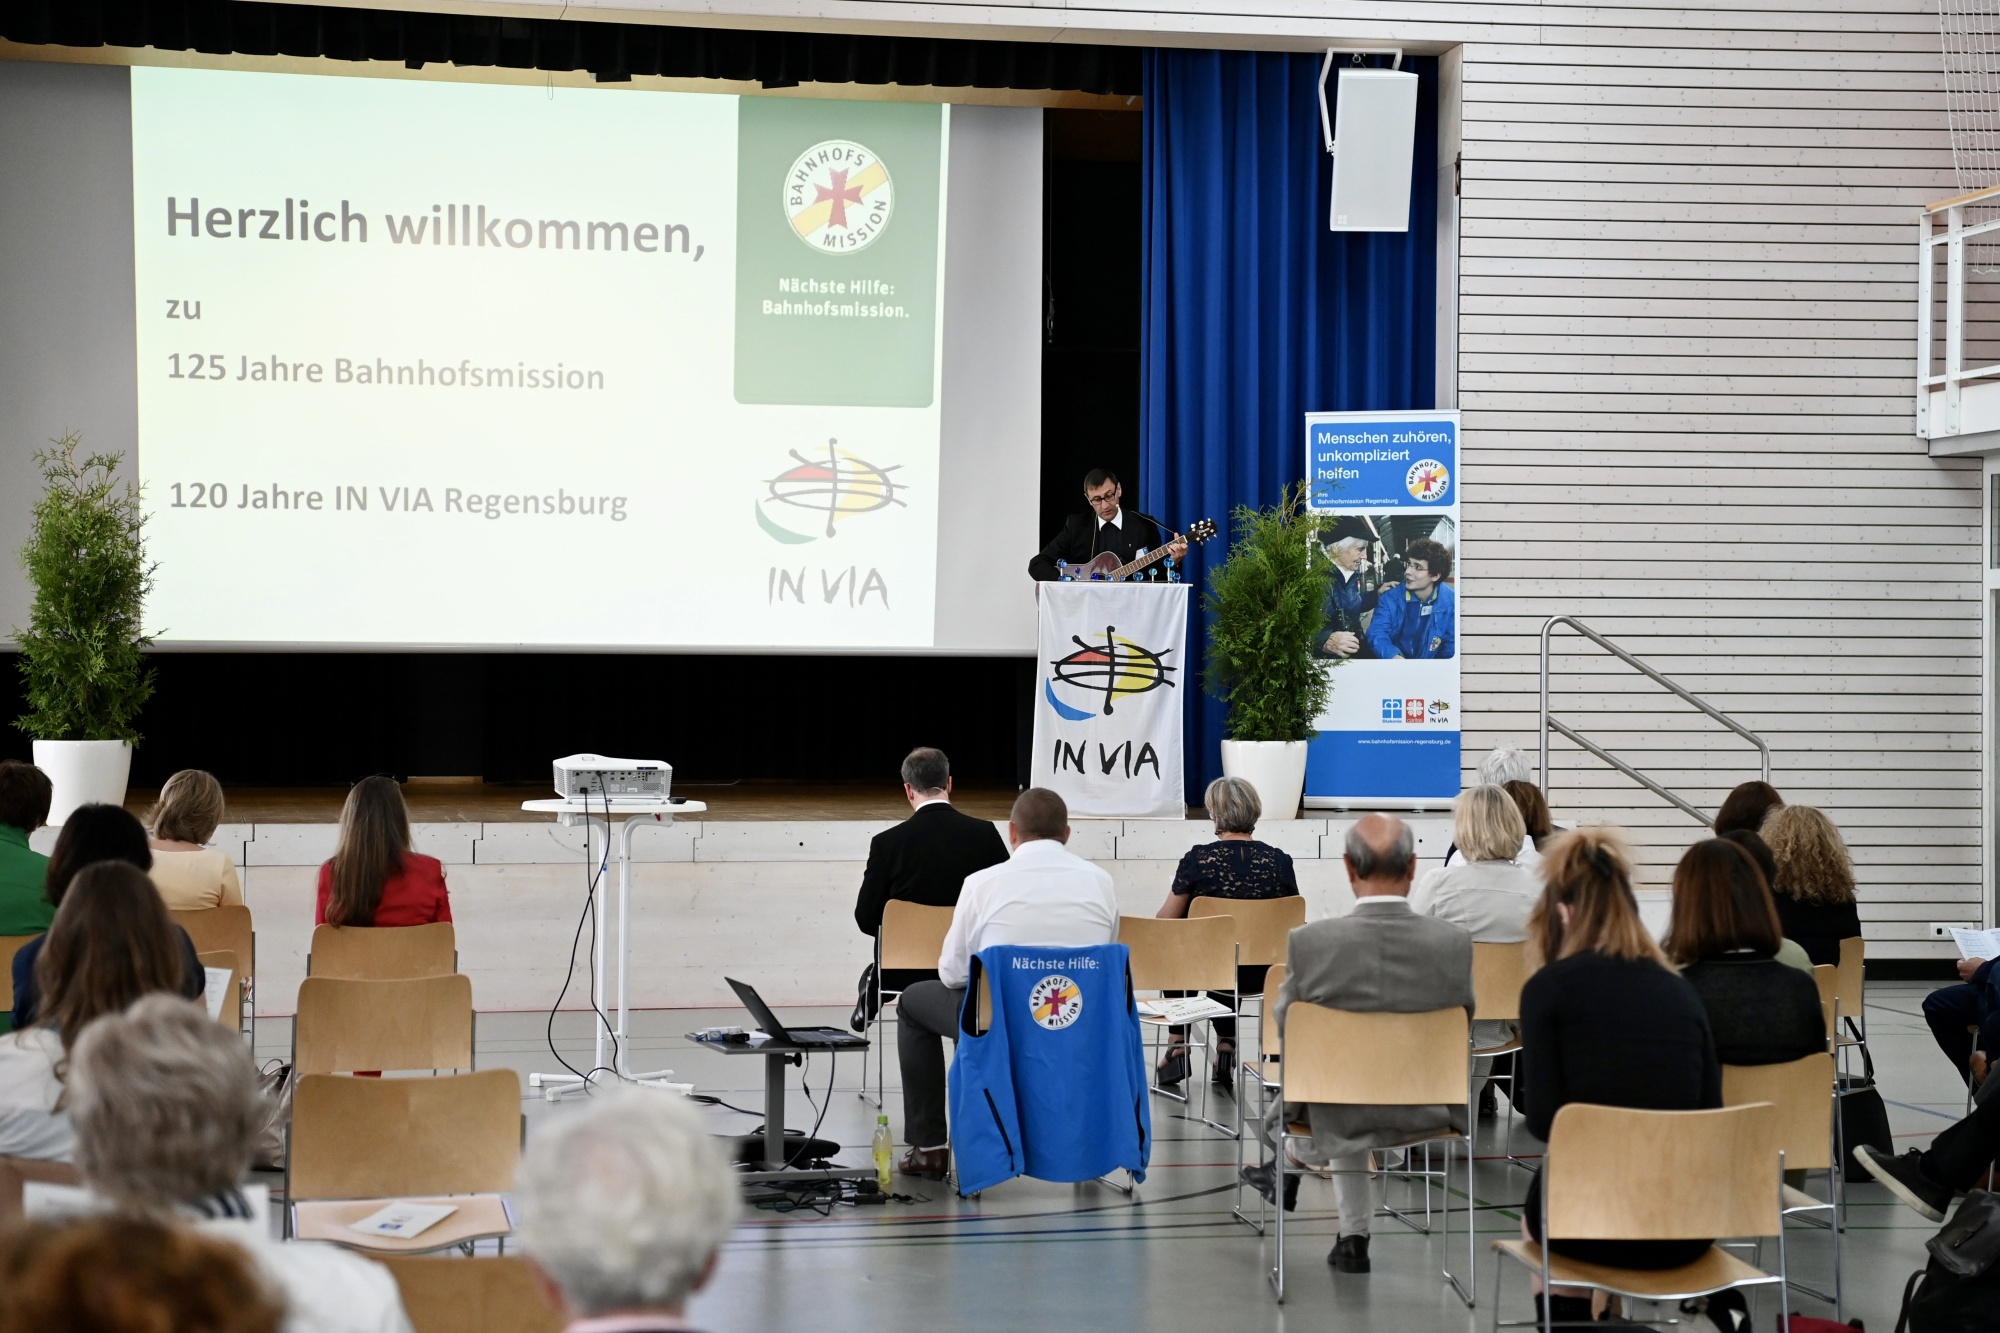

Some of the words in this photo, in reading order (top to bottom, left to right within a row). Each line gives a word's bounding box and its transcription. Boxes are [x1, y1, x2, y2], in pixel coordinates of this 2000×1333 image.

[790, 147, 866, 206] BAHNHOFS
[167, 196, 367, 243] Herzlich
[385, 203, 705, 262] willkommen,
[823, 200, 887, 248] MISSION
[779, 278, 846, 294] Nächste
[850, 280, 895, 295] Hilfe:
[166, 299, 201, 320] zu
[762, 299, 910, 318] Bahnhofsmission.
[168, 353, 226, 380] 125
[236, 354, 323, 383] Jahre
[335, 357, 604, 390] Bahnhofsmission
[1317, 432, 1389, 445] Menschen
[1392, 431, 1452, 445] zuhören,
[1317, 449, 1410, 464] unkompliziert
[1408, 461, 1438, 485] BAHNHOFS
[170, 482, 228, 508] 120
[237, 483, 323, 510] Jahre
[335, 485, 367, 511] IN
[379, 487, 434, 513] VIA
[445, 487, 628, 522] Regensburg
[1421, 480, 1447, 500] MISSION
[769, 565, 806, 606] IN
[821, 565, 890, 611] VIA
[1053, 739, 1087, 775] IN
[1099, 740, 1160, 780] VIA
[1012, 957, 1065, 970] Nächste
[1068, 956, 1099, 970] Hilfe:
[1032, 977, 1069, 1007] BAHNHOFS
[1047, 1002, 1079, 1026] MISSION
